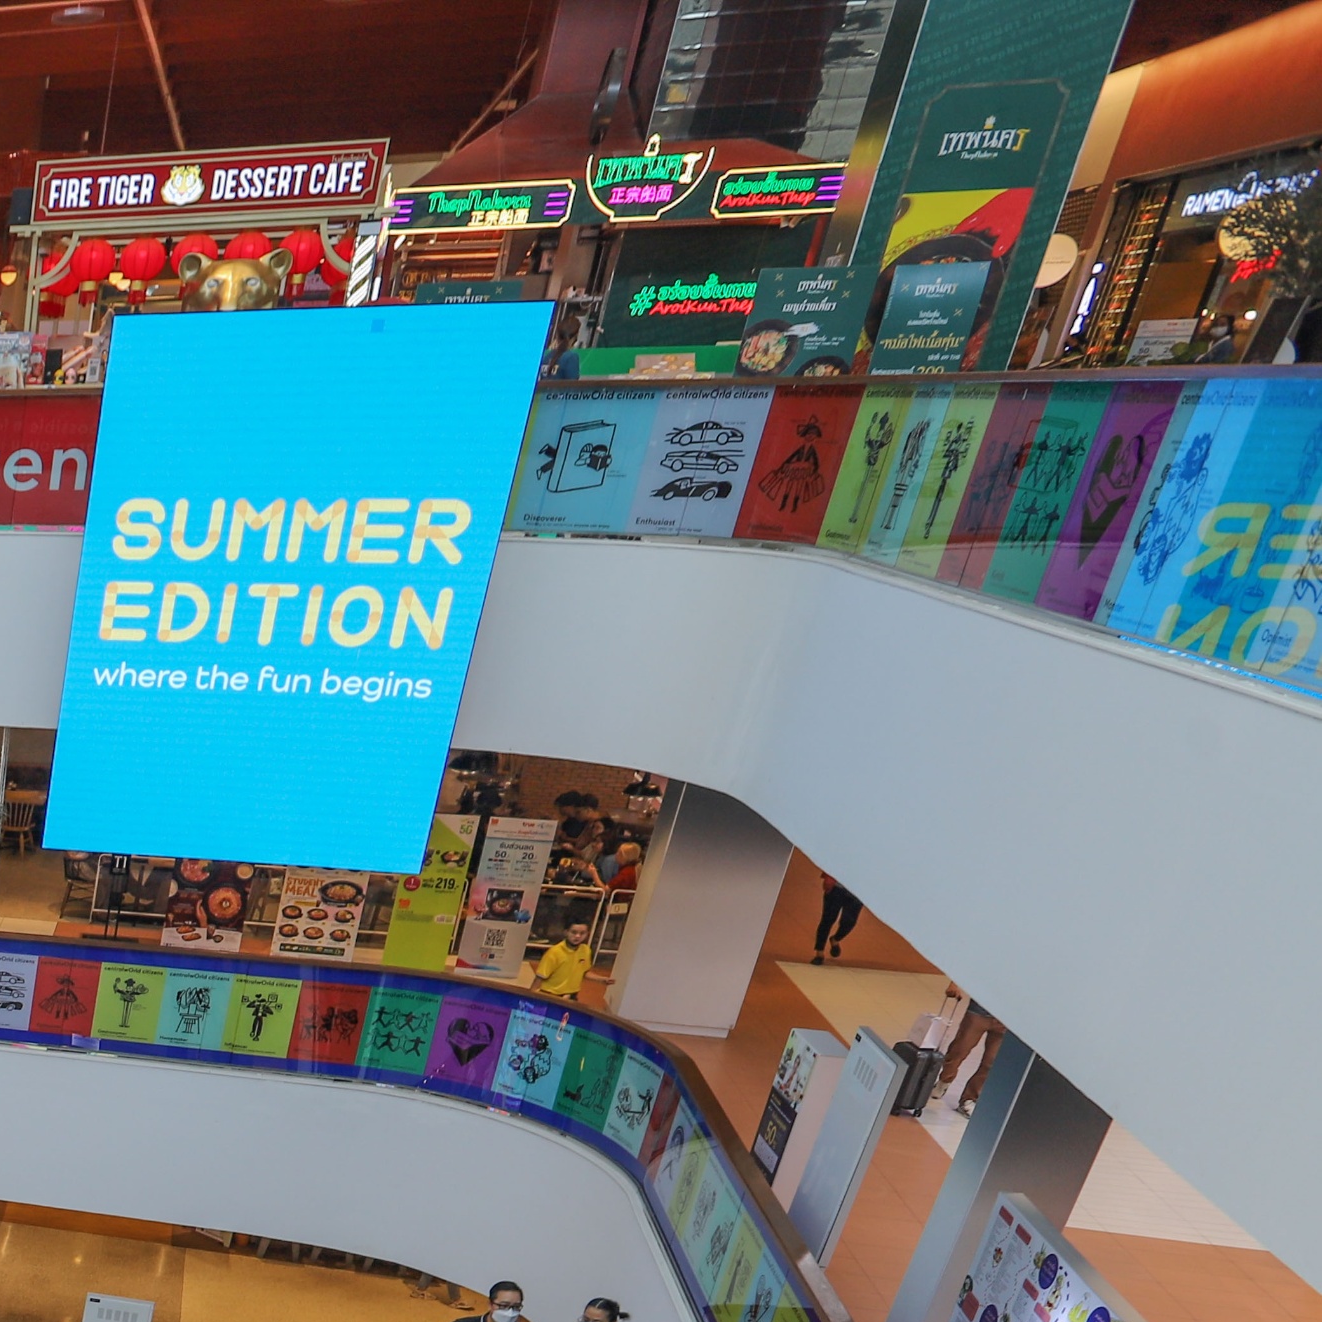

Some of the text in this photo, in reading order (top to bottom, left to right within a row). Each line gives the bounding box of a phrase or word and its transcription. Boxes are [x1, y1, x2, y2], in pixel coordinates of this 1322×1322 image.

[49, 160, 367, 209] FIRE TIGER DESSERT CAFE
[608, 184, 673, 205] 正宗船面
[428, 190, 532, 217] ThepNakorn
[1181, 188, 1233, 217] RAMEN
[468, 208, 529, 227] 正宗船面
[546, 389, 656, 401] centralwOrld citizens
[666, 388, 769, 401] centralwOrld citizens
[112, 498, 472, 565] SUMMER
[635, 517, 676, 527] Enthusiast
[99, 581, 454, 652] EDITION
[93, 661, 433, 703] where the fun begins
[459, 824, 474, 836] 5G
[285, 884, 318, 899] MEAL
[287, 876, 325, 888] STUDENT
